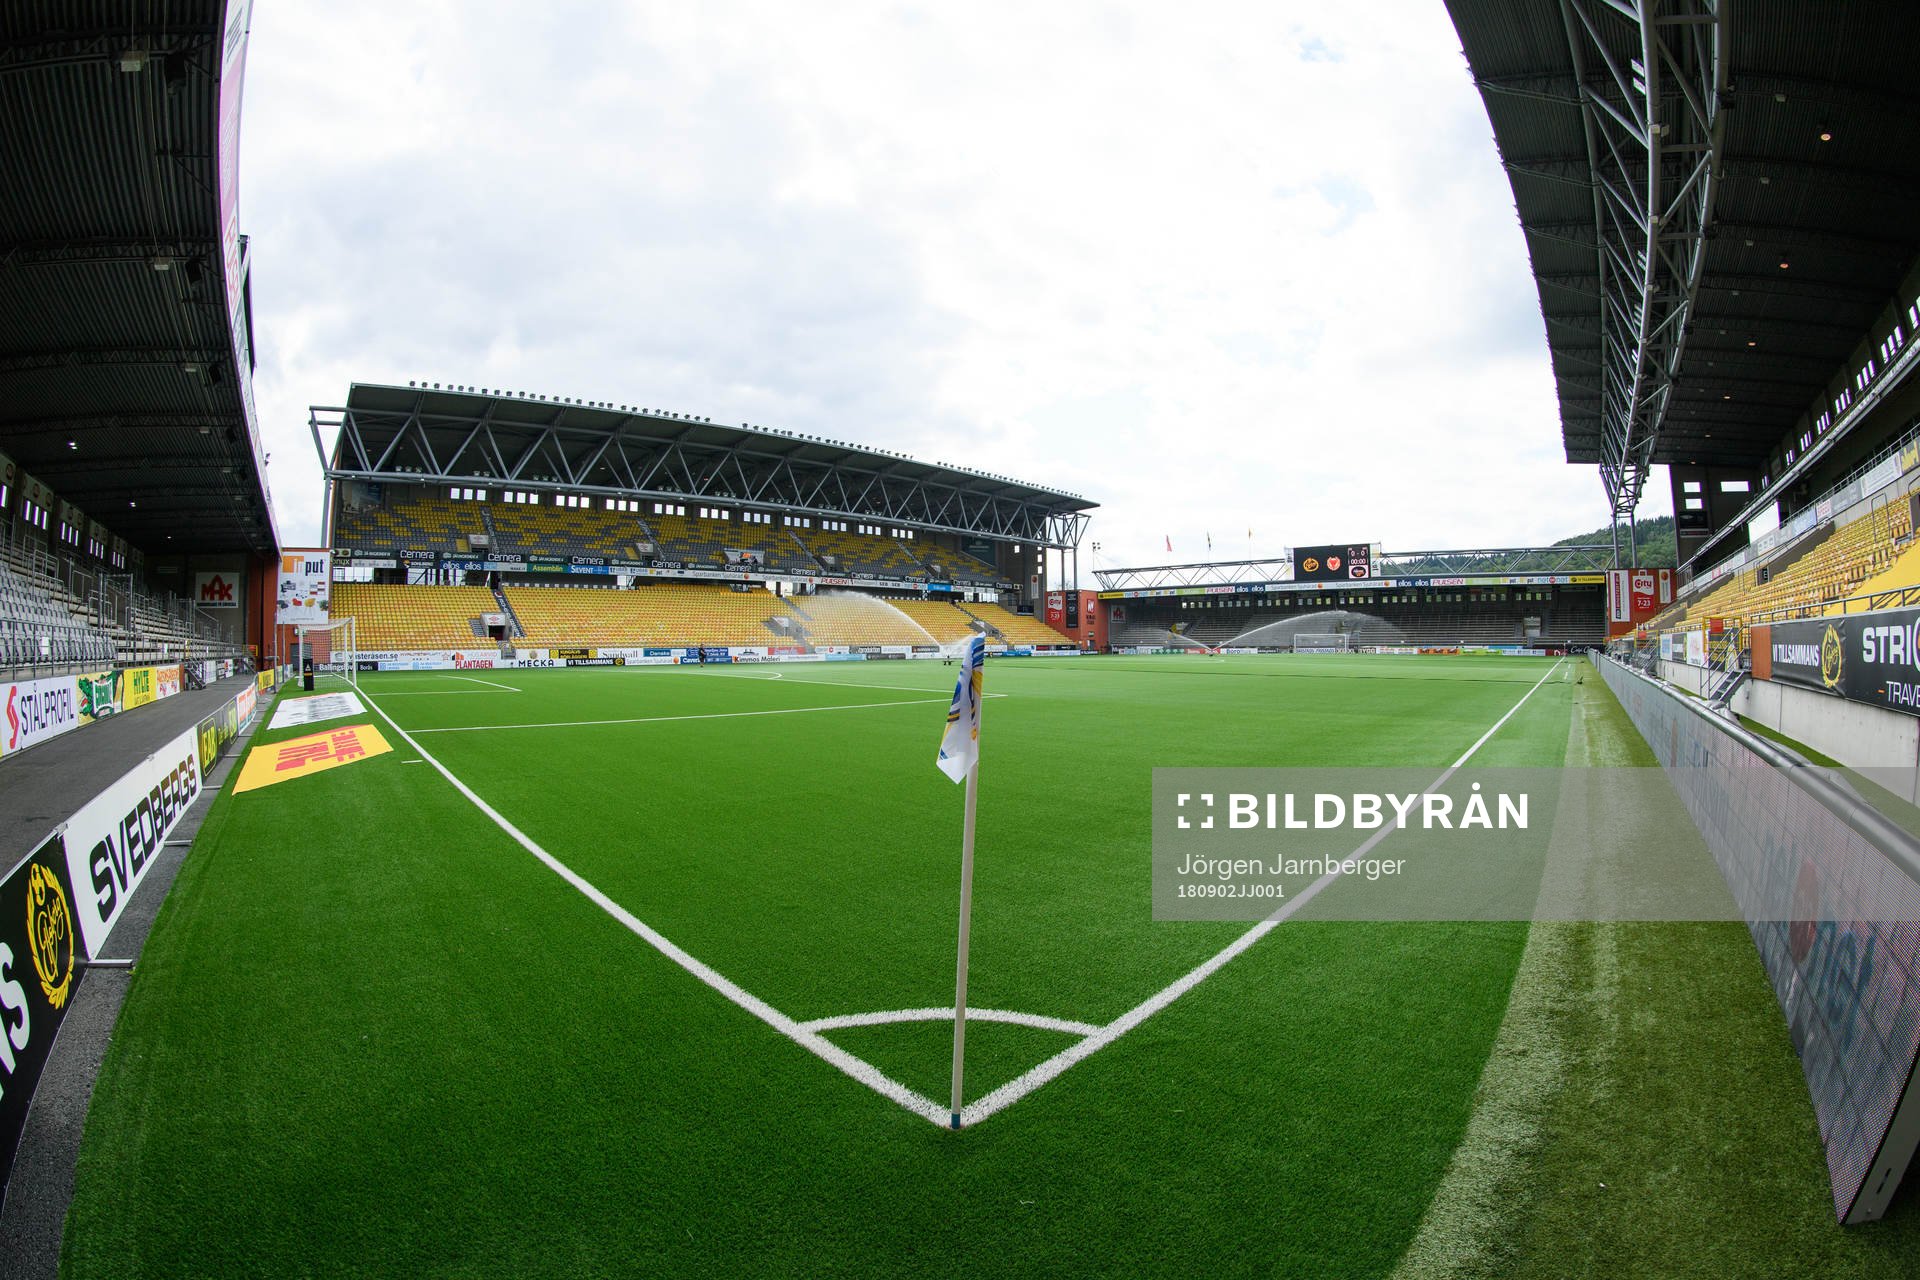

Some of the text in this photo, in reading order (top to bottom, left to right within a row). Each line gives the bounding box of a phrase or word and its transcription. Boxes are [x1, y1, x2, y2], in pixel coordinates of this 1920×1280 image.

[1635, 579, 1652, 589] City
[1778, 644, 1820, 667] TILLSAMMANS
[1863, 617, 1920, 673] STRI
[455, 659, 493, 669] PLANTAGEN
[518, 659, 554, 668] MECKA
[21, 682, 74, 736] STÅLPROFIL
[89, 754, 197, 923] SVEDBERGS
